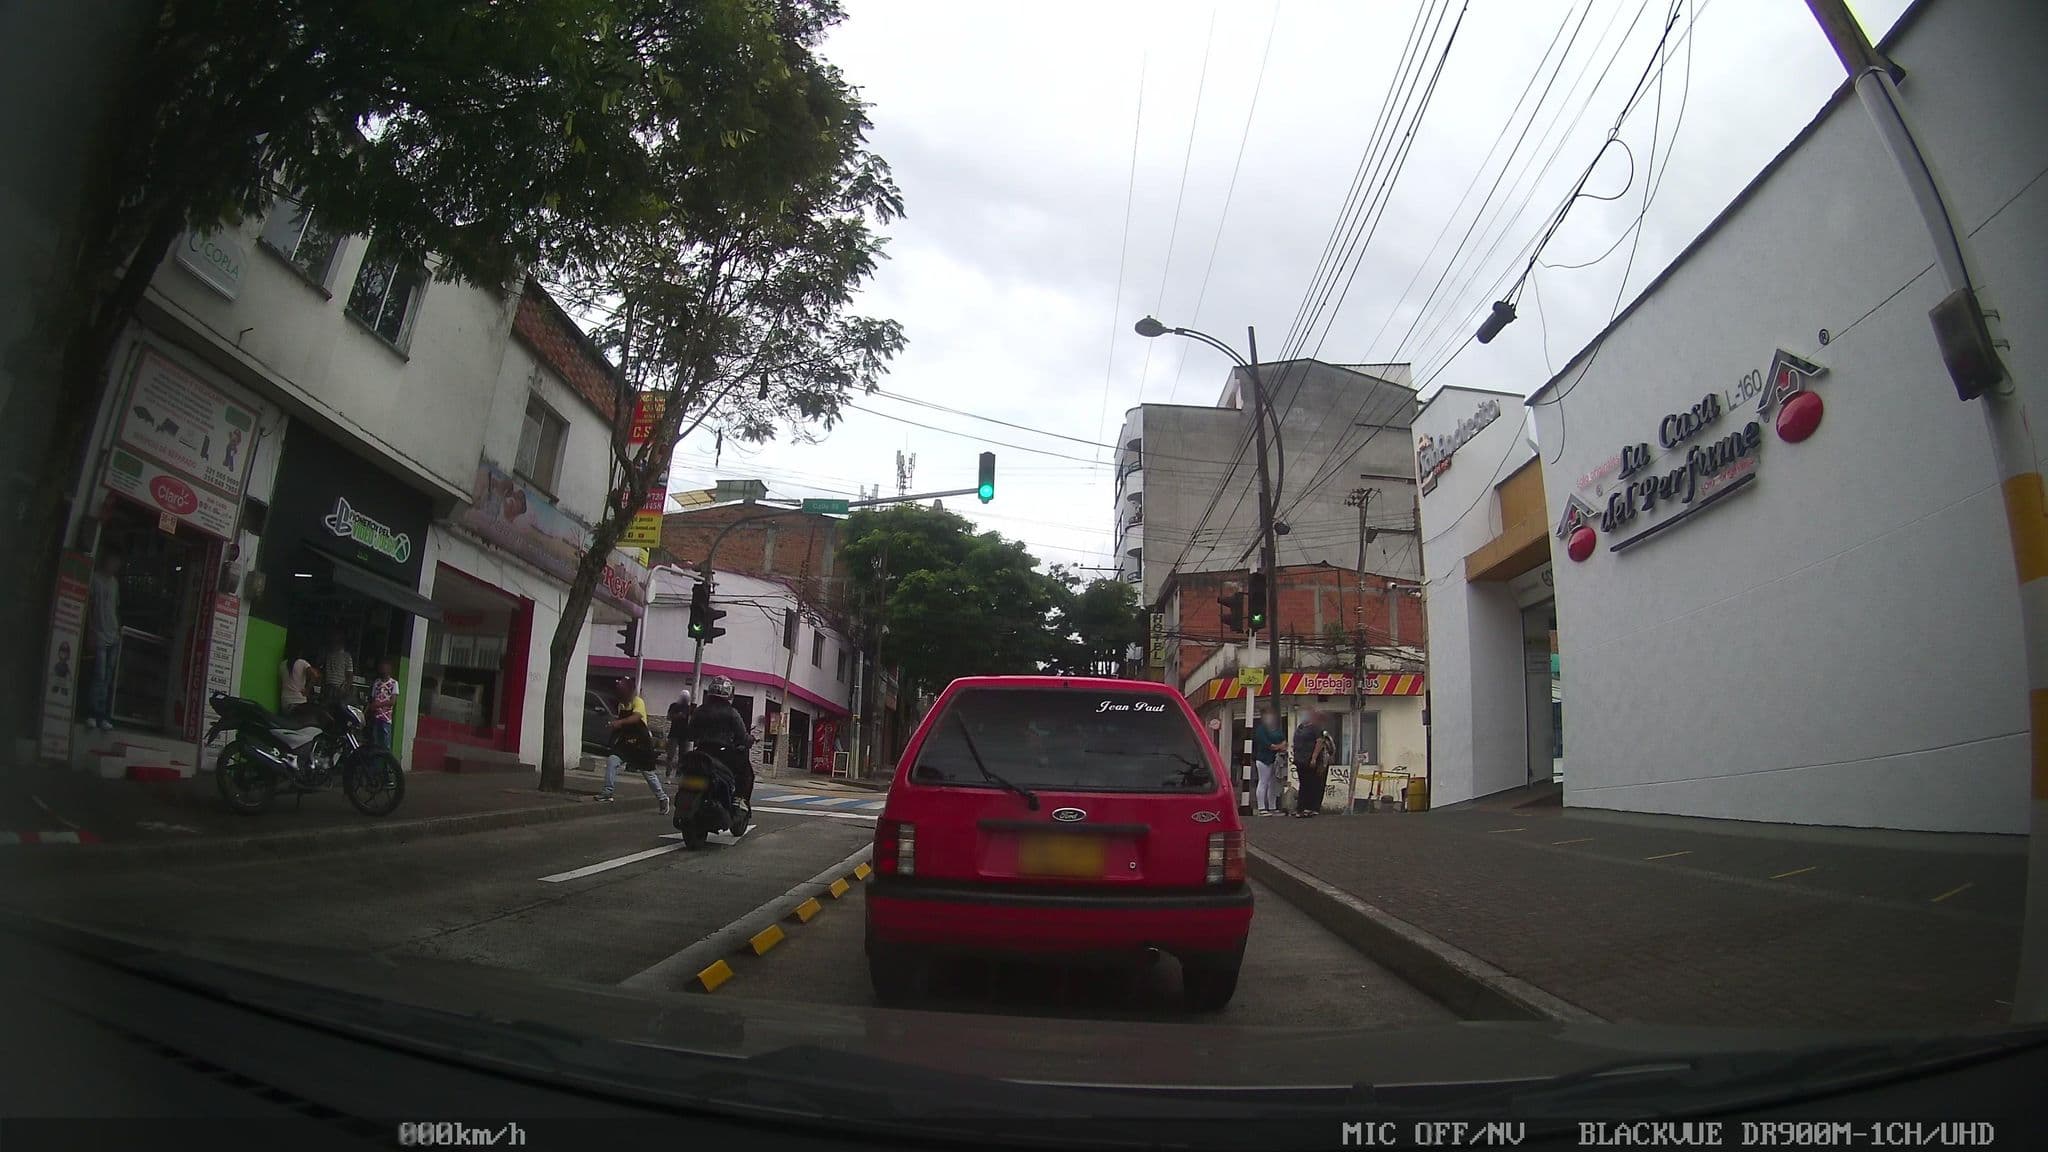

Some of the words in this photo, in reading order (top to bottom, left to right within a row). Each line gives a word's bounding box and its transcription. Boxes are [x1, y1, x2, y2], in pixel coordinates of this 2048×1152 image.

[1618, 442, 1651, 481] La
[1658, 393, 1721, 450] Casa
[1600, 481, 1638, 533] del
[1638, 421, 1762, 511] Perfume
[158, 486, 185, 506] Claro
[1153, 614, 1163, 660] HOTEL
[1317, 677, 1352, 692] rebaja
[1096, 700, 1129, 713] Jean
[1133, 701, 1166, 712] Paul
[1059, 810, 1078, 820] Ford
